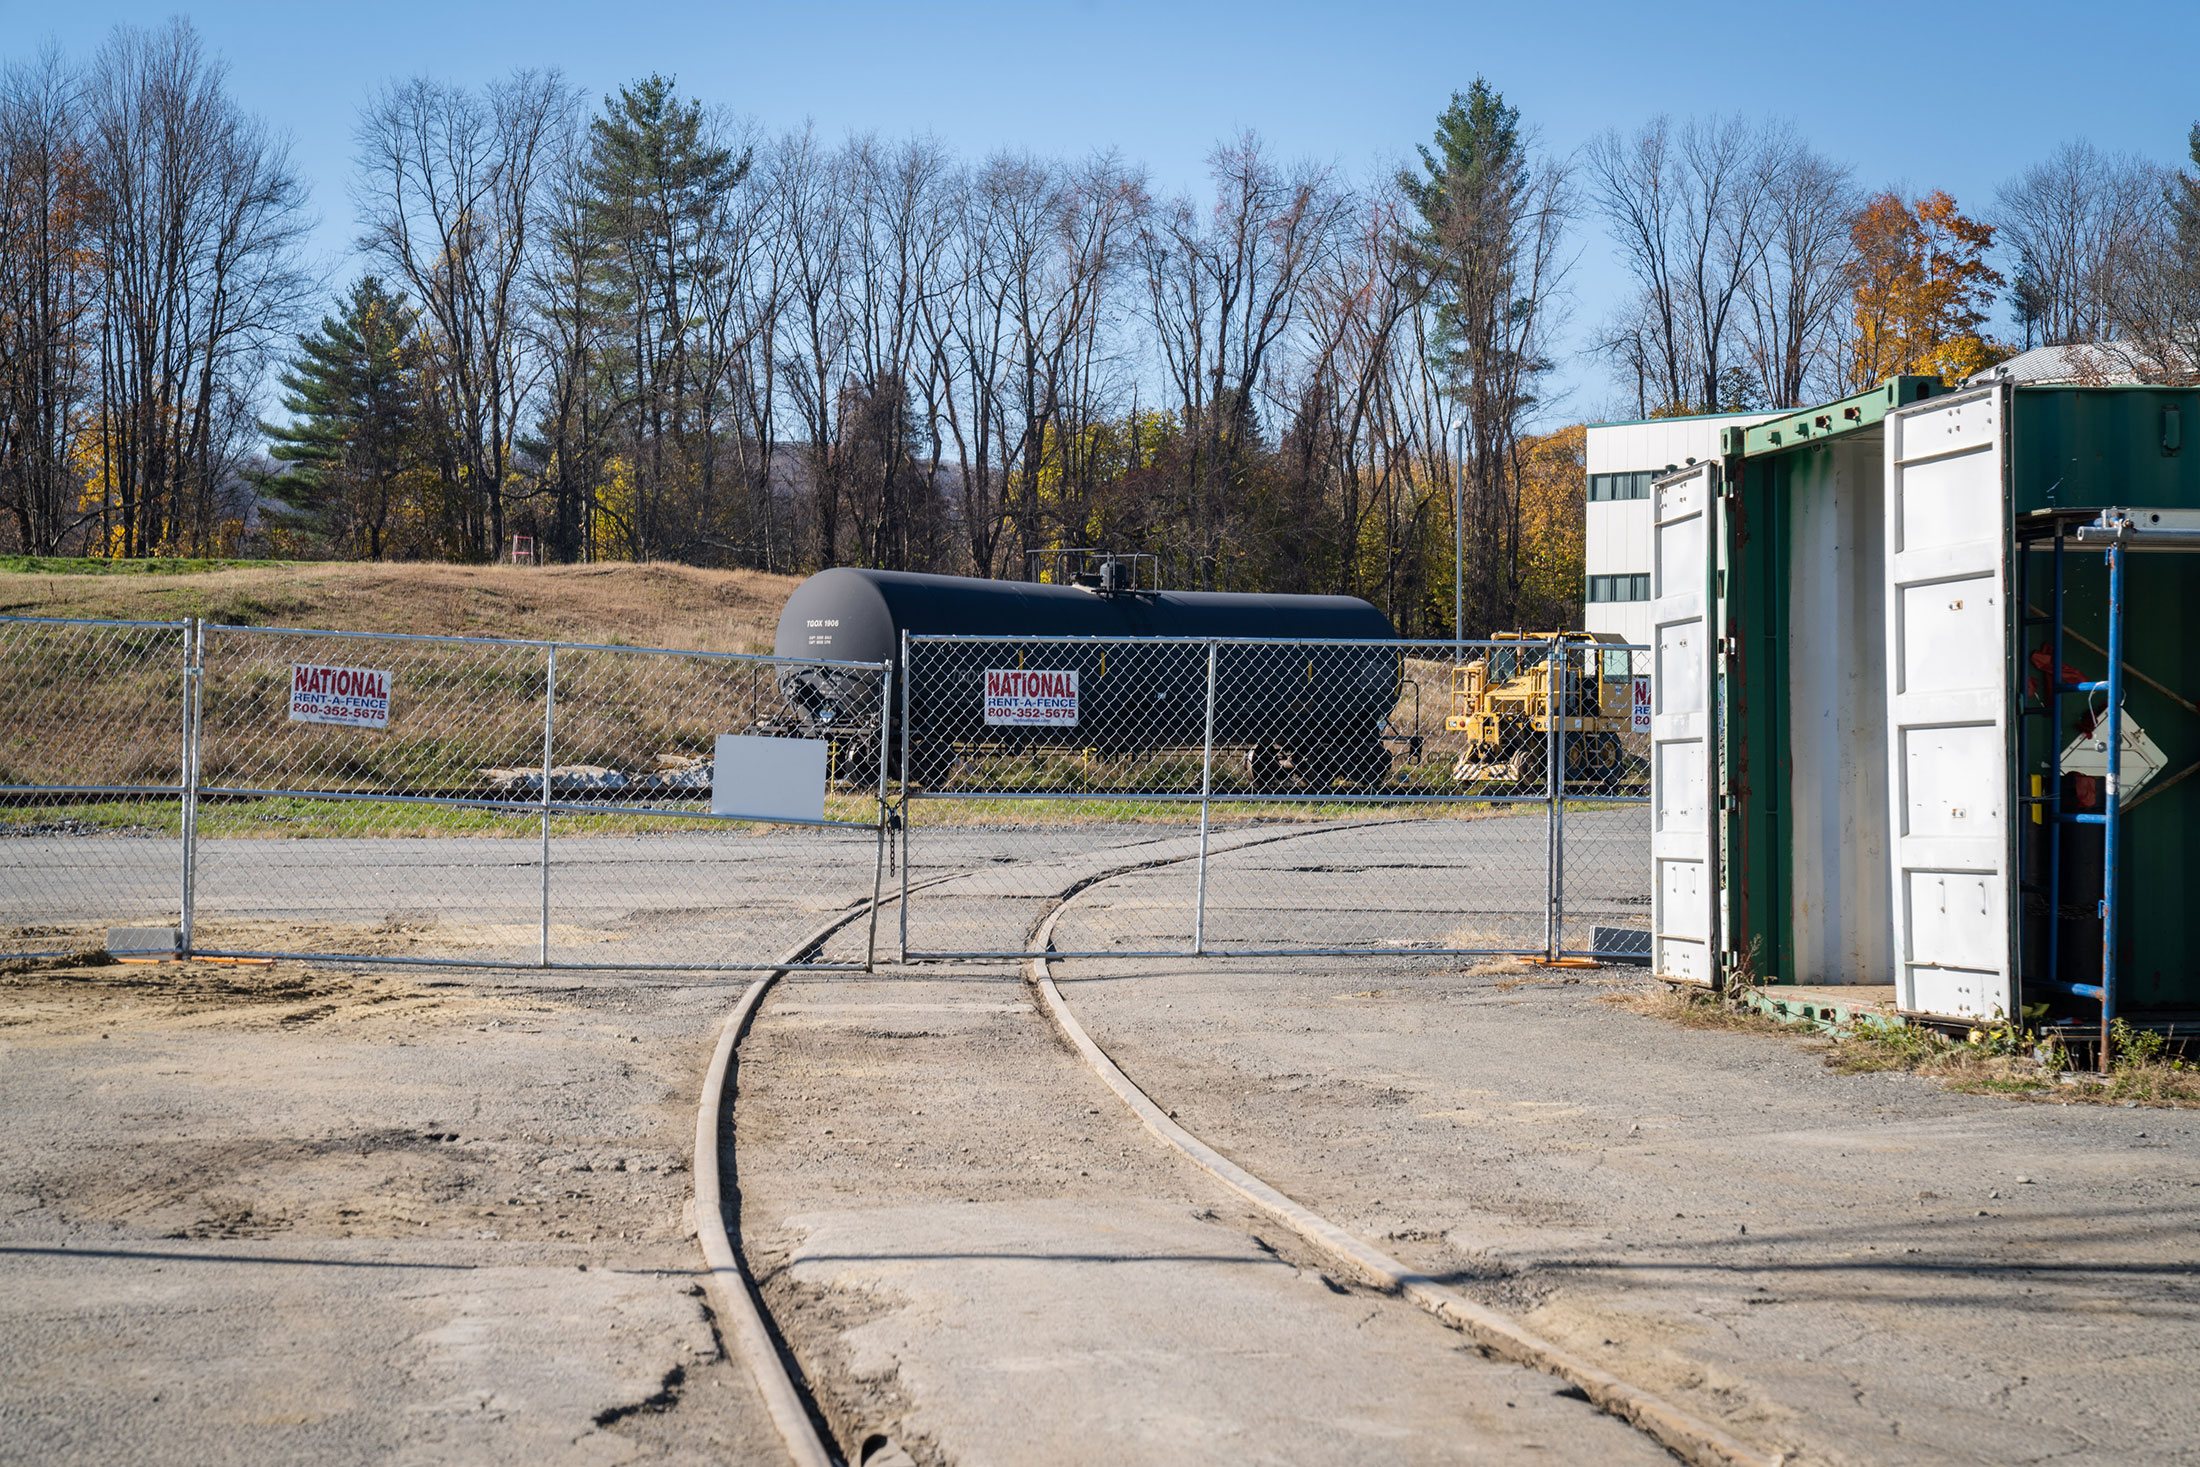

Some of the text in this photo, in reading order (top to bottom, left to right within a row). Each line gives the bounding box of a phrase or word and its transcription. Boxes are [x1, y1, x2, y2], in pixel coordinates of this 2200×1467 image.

[294, 666, 388, 700] NATIONAL
[987, 671, 1076, 698] NATIONAL
[294, 692, 387, 709] RENT-A-FENCE
[988, 697, 1076, 708] RENT-A-FENCE
[293, 702, 385, 720] 800-352-5675
[987, 708, 1075, 719] 800-352-5675
